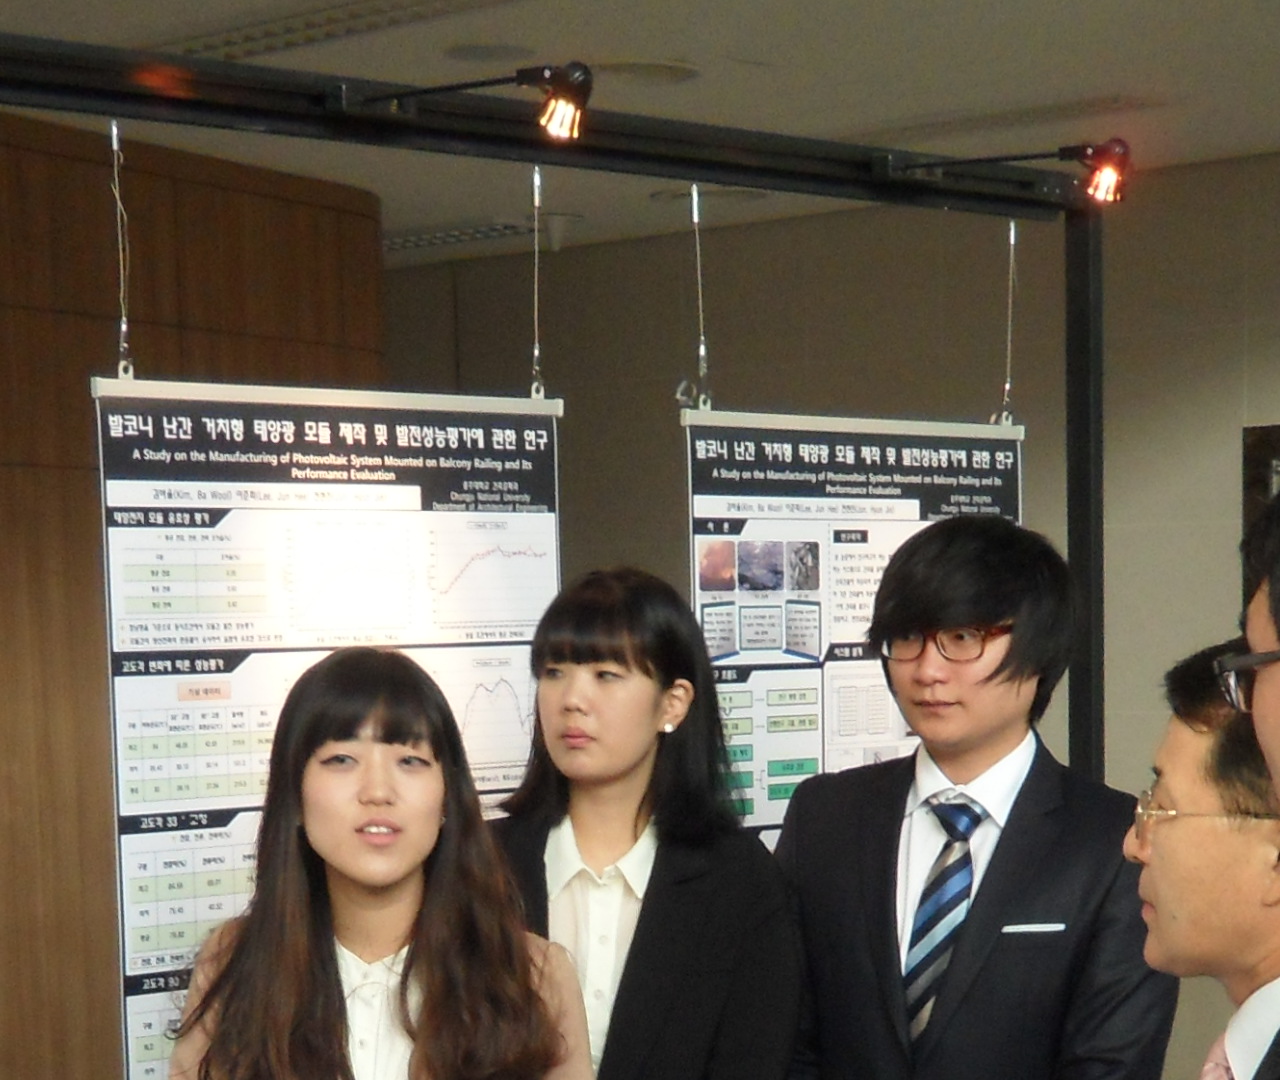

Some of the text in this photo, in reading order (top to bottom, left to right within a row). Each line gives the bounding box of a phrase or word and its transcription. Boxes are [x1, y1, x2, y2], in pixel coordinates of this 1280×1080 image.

[108, 413, 153, 438] 발코니
[163, 416, 192, 439] 난간
[201, 417, 244, 441] 거치형
[253, 419, 295, 443] 태양광
[304, 421, 331, 444] 모듈
[339, 422, 366, 445] 제작
[374, 424, 388, 445] 및
[491, 428, 517, 450] 관한
[523, 430, 548, 450] 연구
[133, 449, 141, 459] A
[143, 449, 171, 462] Study
[174, 452, 187, 460] on
[189, 450, 206, 461] the
[209, 451, 277, 466] Manufacturing
[280, 453, 290, 463] of
[292, 453, 347, 466] Photovoltaic
[351, 455, 382, 467] System
[384, 455, 423, 467] Mounted
[426, 458, 437, 467] on
[439, 457, 471, 470] Balcony
[504, 460, 519, 469] and
[291, 468, 396, 480] Performance Evaluation
